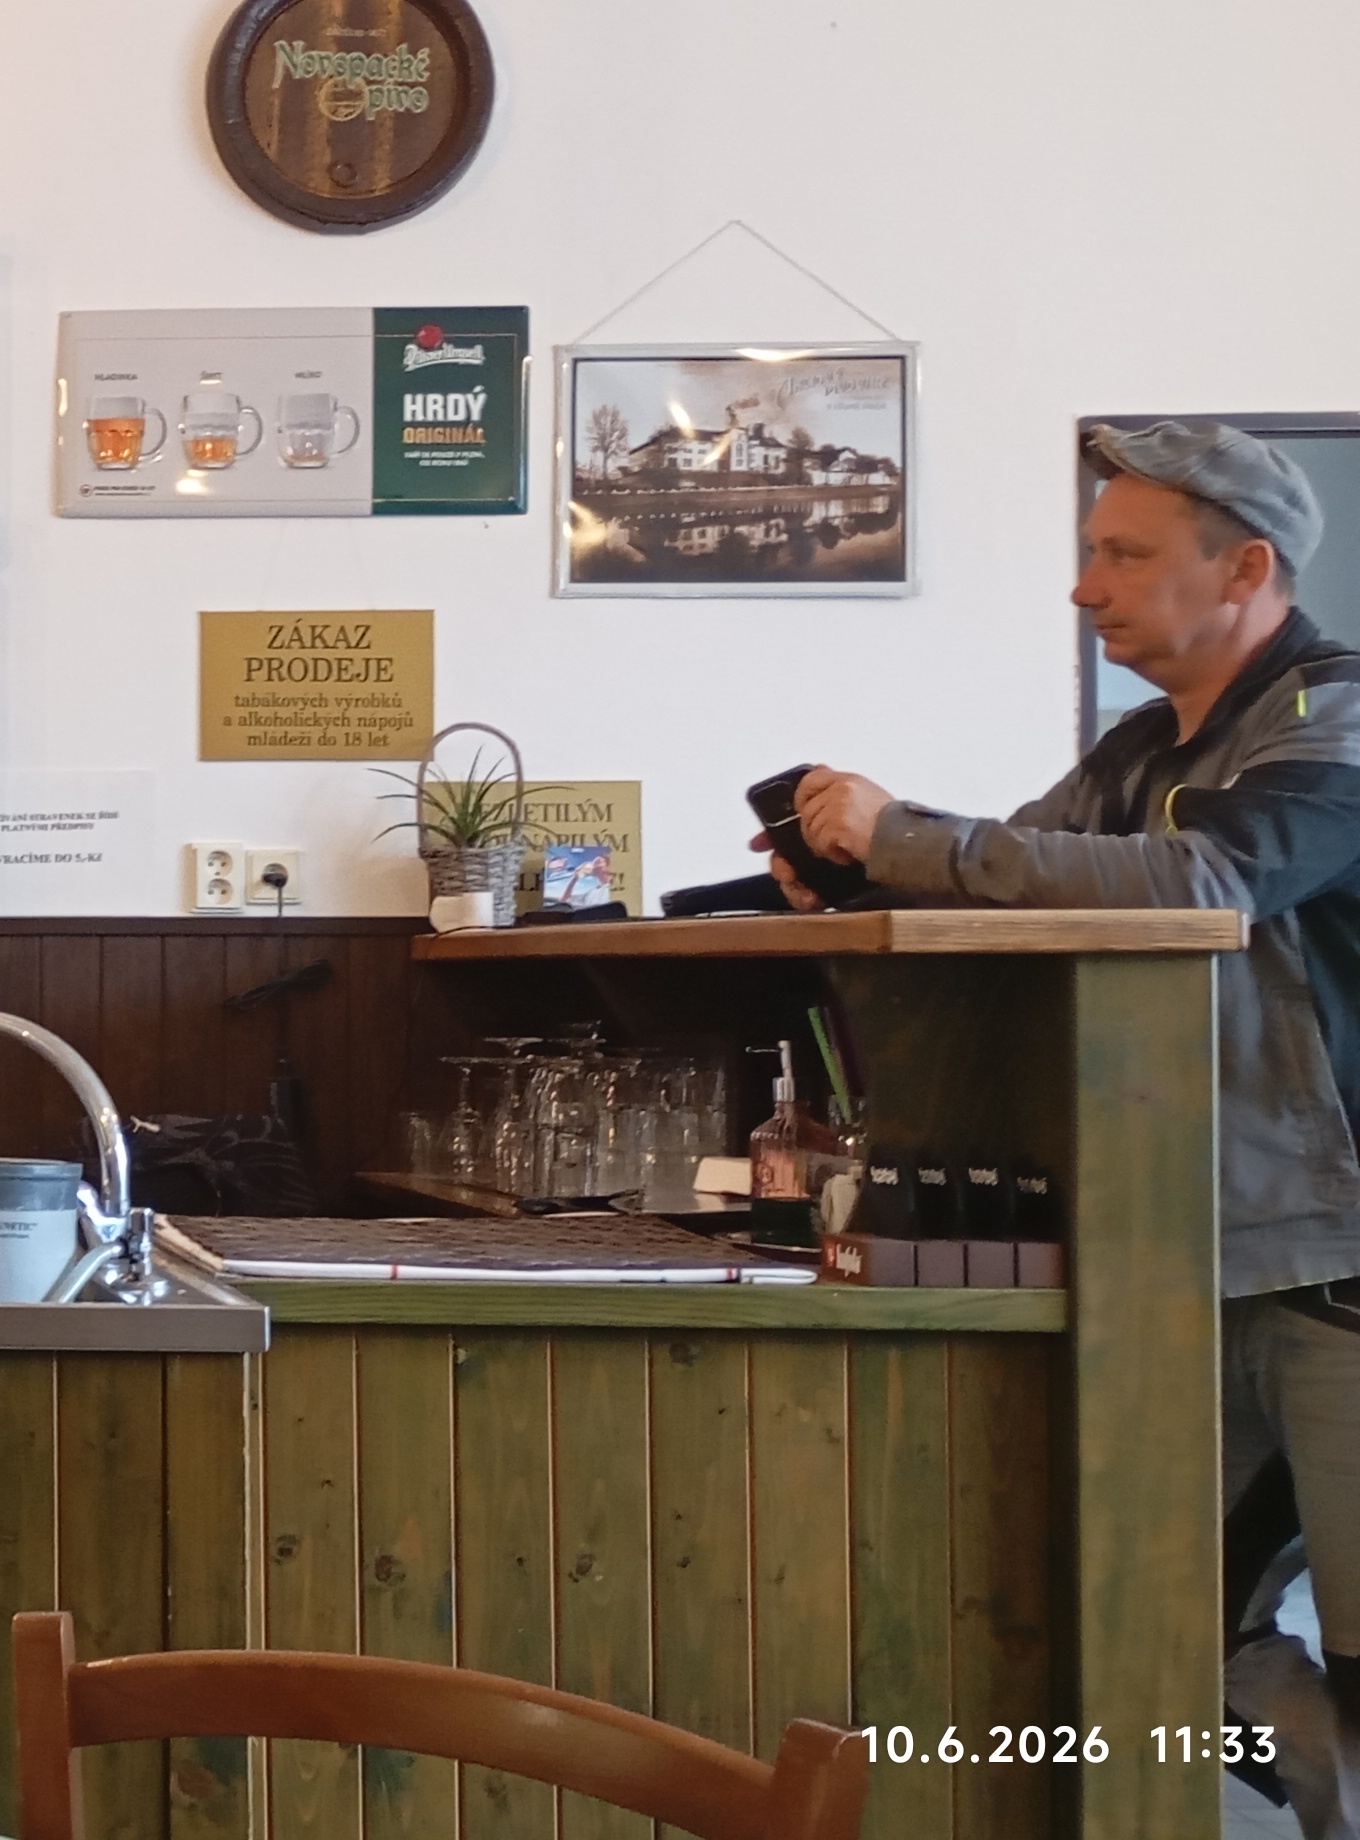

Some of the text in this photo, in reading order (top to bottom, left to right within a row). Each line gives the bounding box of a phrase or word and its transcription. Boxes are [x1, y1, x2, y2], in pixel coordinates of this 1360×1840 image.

[272, 40, 430, 89] Novopacké
[365, 81, 429, 121] pivo
[402, 385, 487, 422] HRDÝ
[266, 618, 372, 651] ZÁKAZ
[243, 656, 395, 683] PRODEJE
[234, 692, 403, 711] tabákových výrobků
[222, 711, 414, 731] a alkoholických nápojů
[317, 732, 337, 747] do
[344, 732, 362, 747] 18
[368, 732, 390, 747] let
[470, 798, 614, 823] EZLETILÝM
[55, 854, 72, 863] DO
